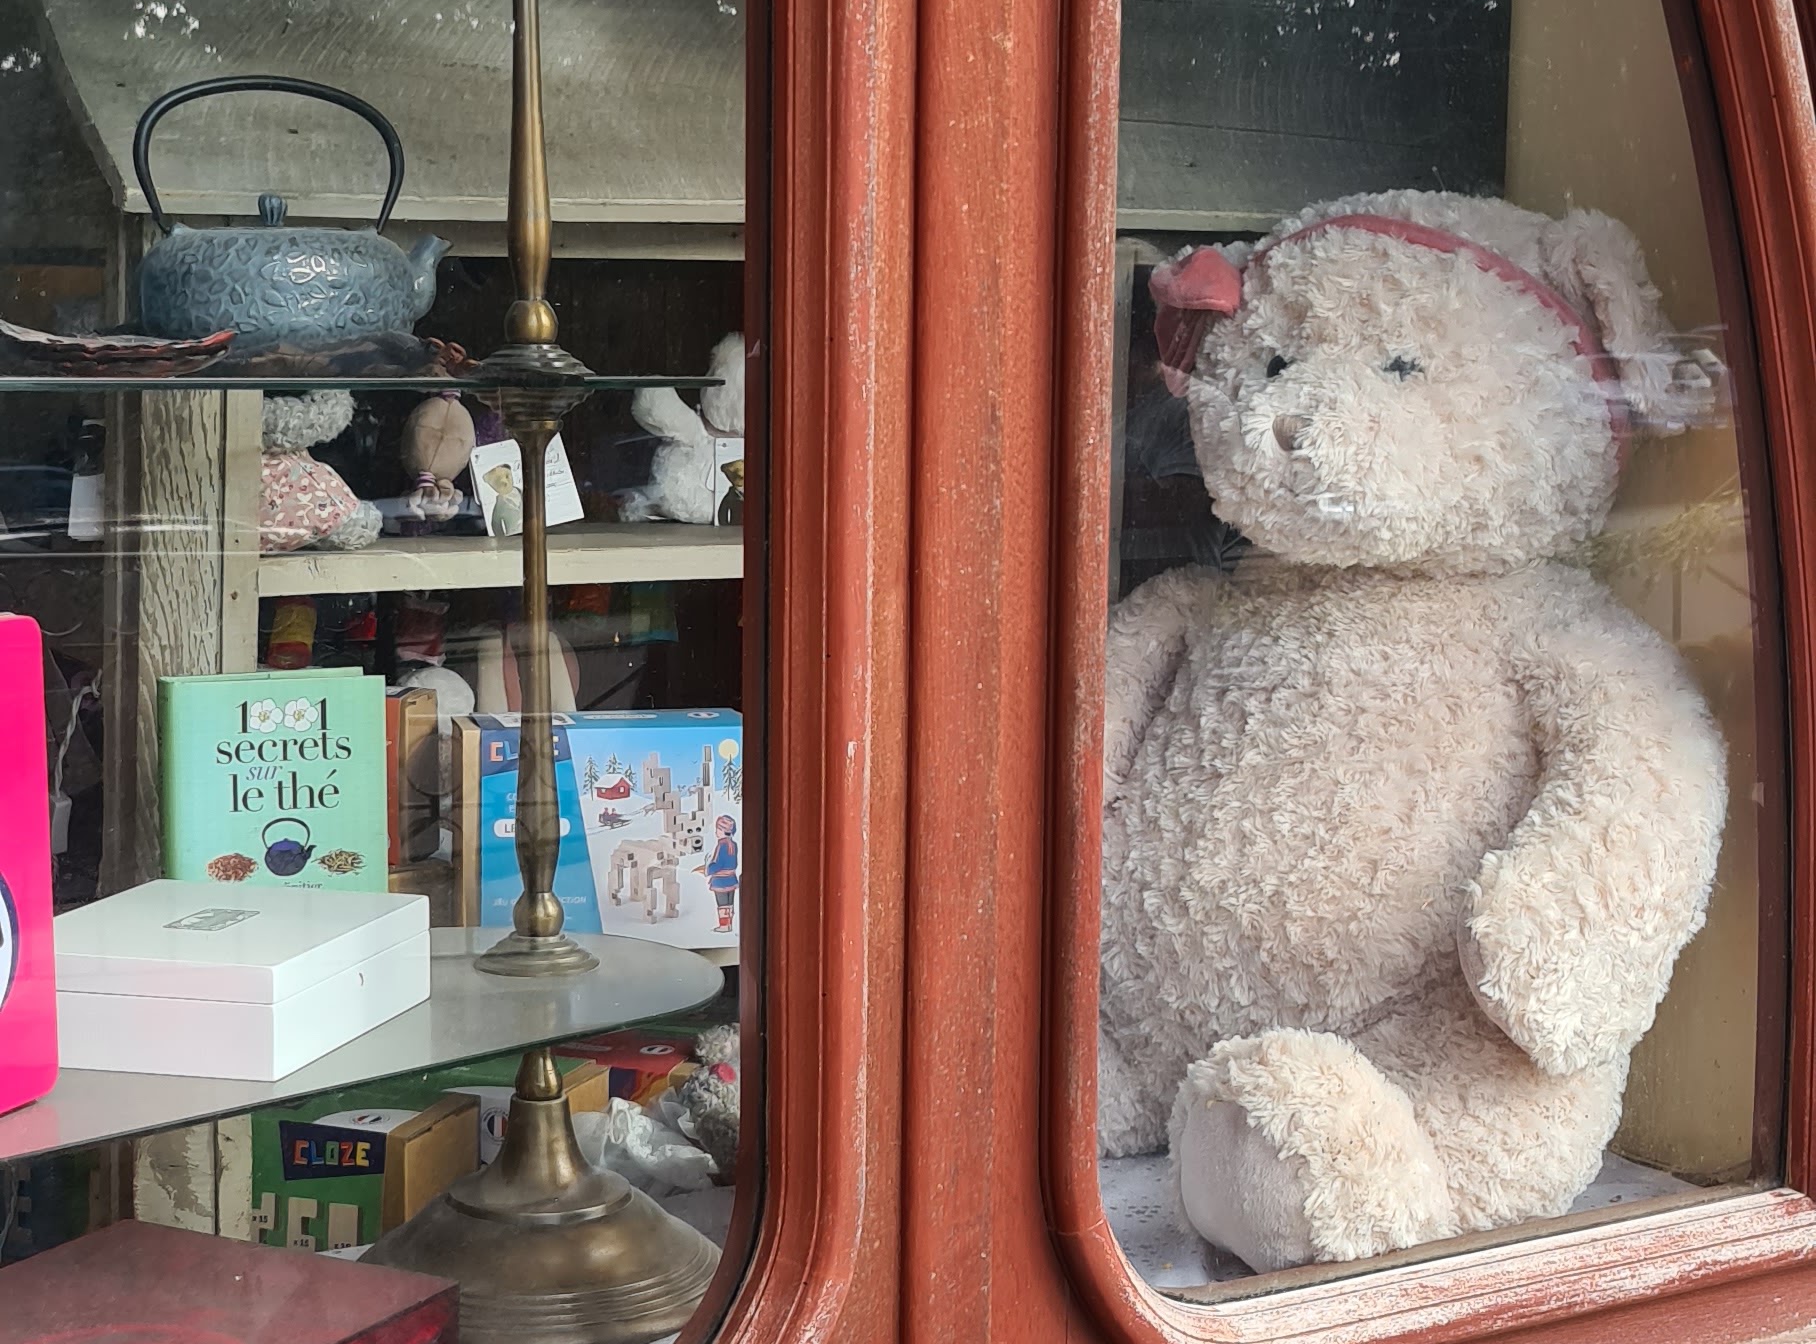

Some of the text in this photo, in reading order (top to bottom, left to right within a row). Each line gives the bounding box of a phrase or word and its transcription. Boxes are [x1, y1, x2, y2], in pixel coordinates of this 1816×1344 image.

[216, 731, 352, 765] secrets
[246, 765, 283, 782] sur
[229, 768, 340, 813] le thé
[293, 1139, 371, 1168] CLOZE
